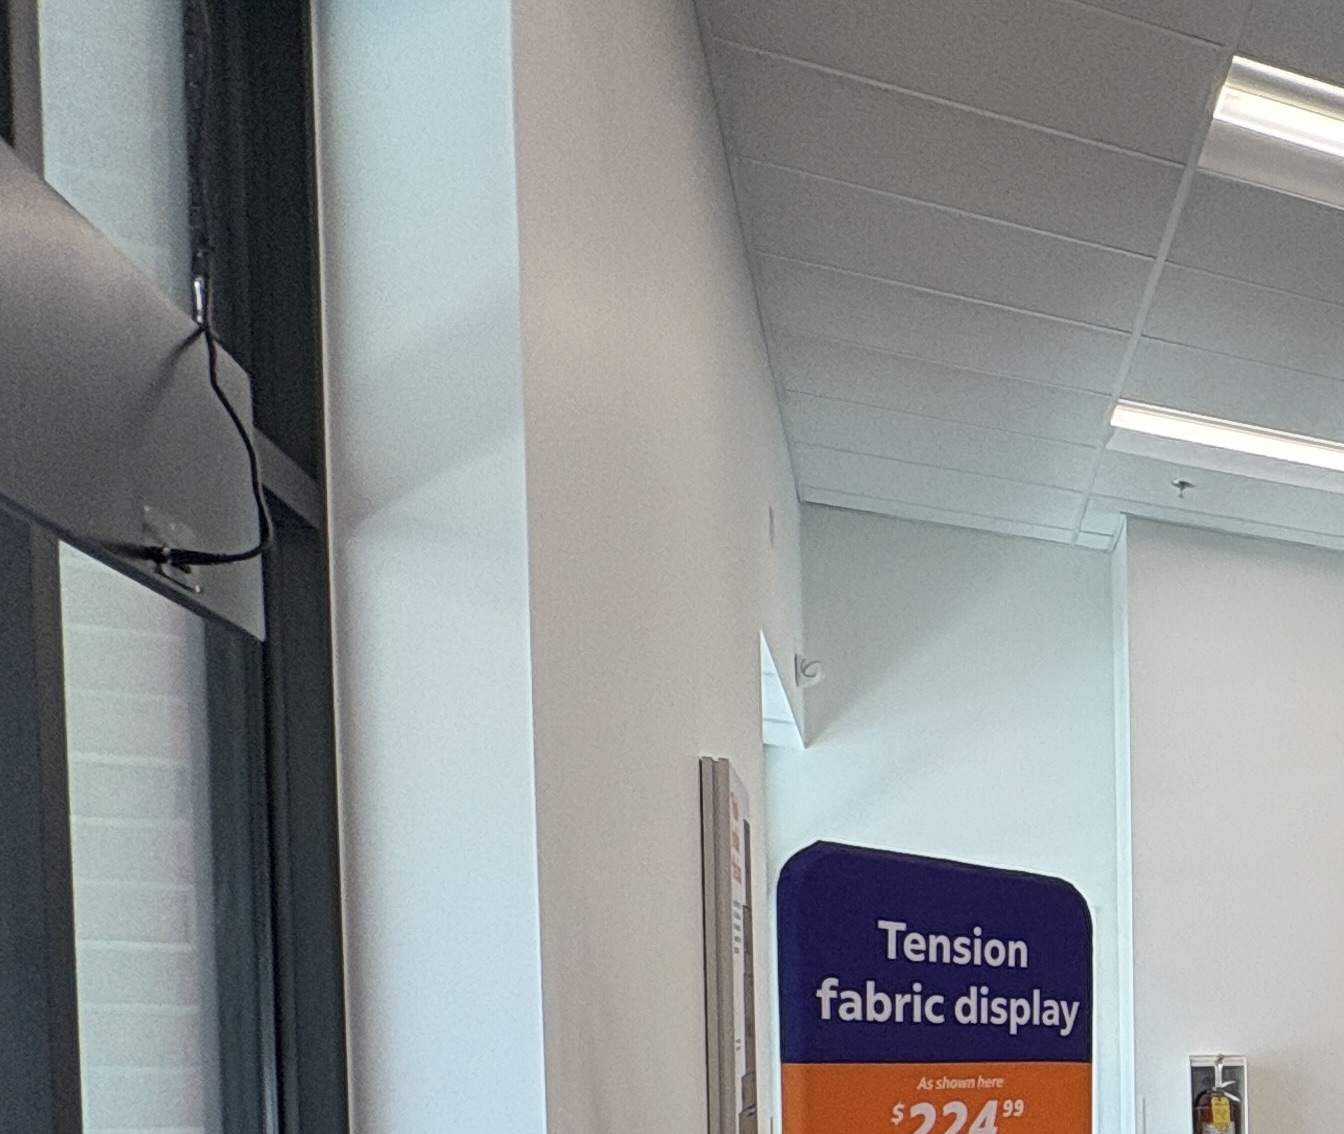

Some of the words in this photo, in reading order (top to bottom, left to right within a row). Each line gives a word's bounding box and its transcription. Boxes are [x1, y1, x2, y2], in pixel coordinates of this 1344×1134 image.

[878, 920, 1028, 968] Tension
[816, 977, 945, 1023] fabric
[955, 986, 1080, 1036] display
[917, 1077, 933, 1091] As
[936, 1077, 976, 1091] shown
[977, 1076, 1004, 1089] here
